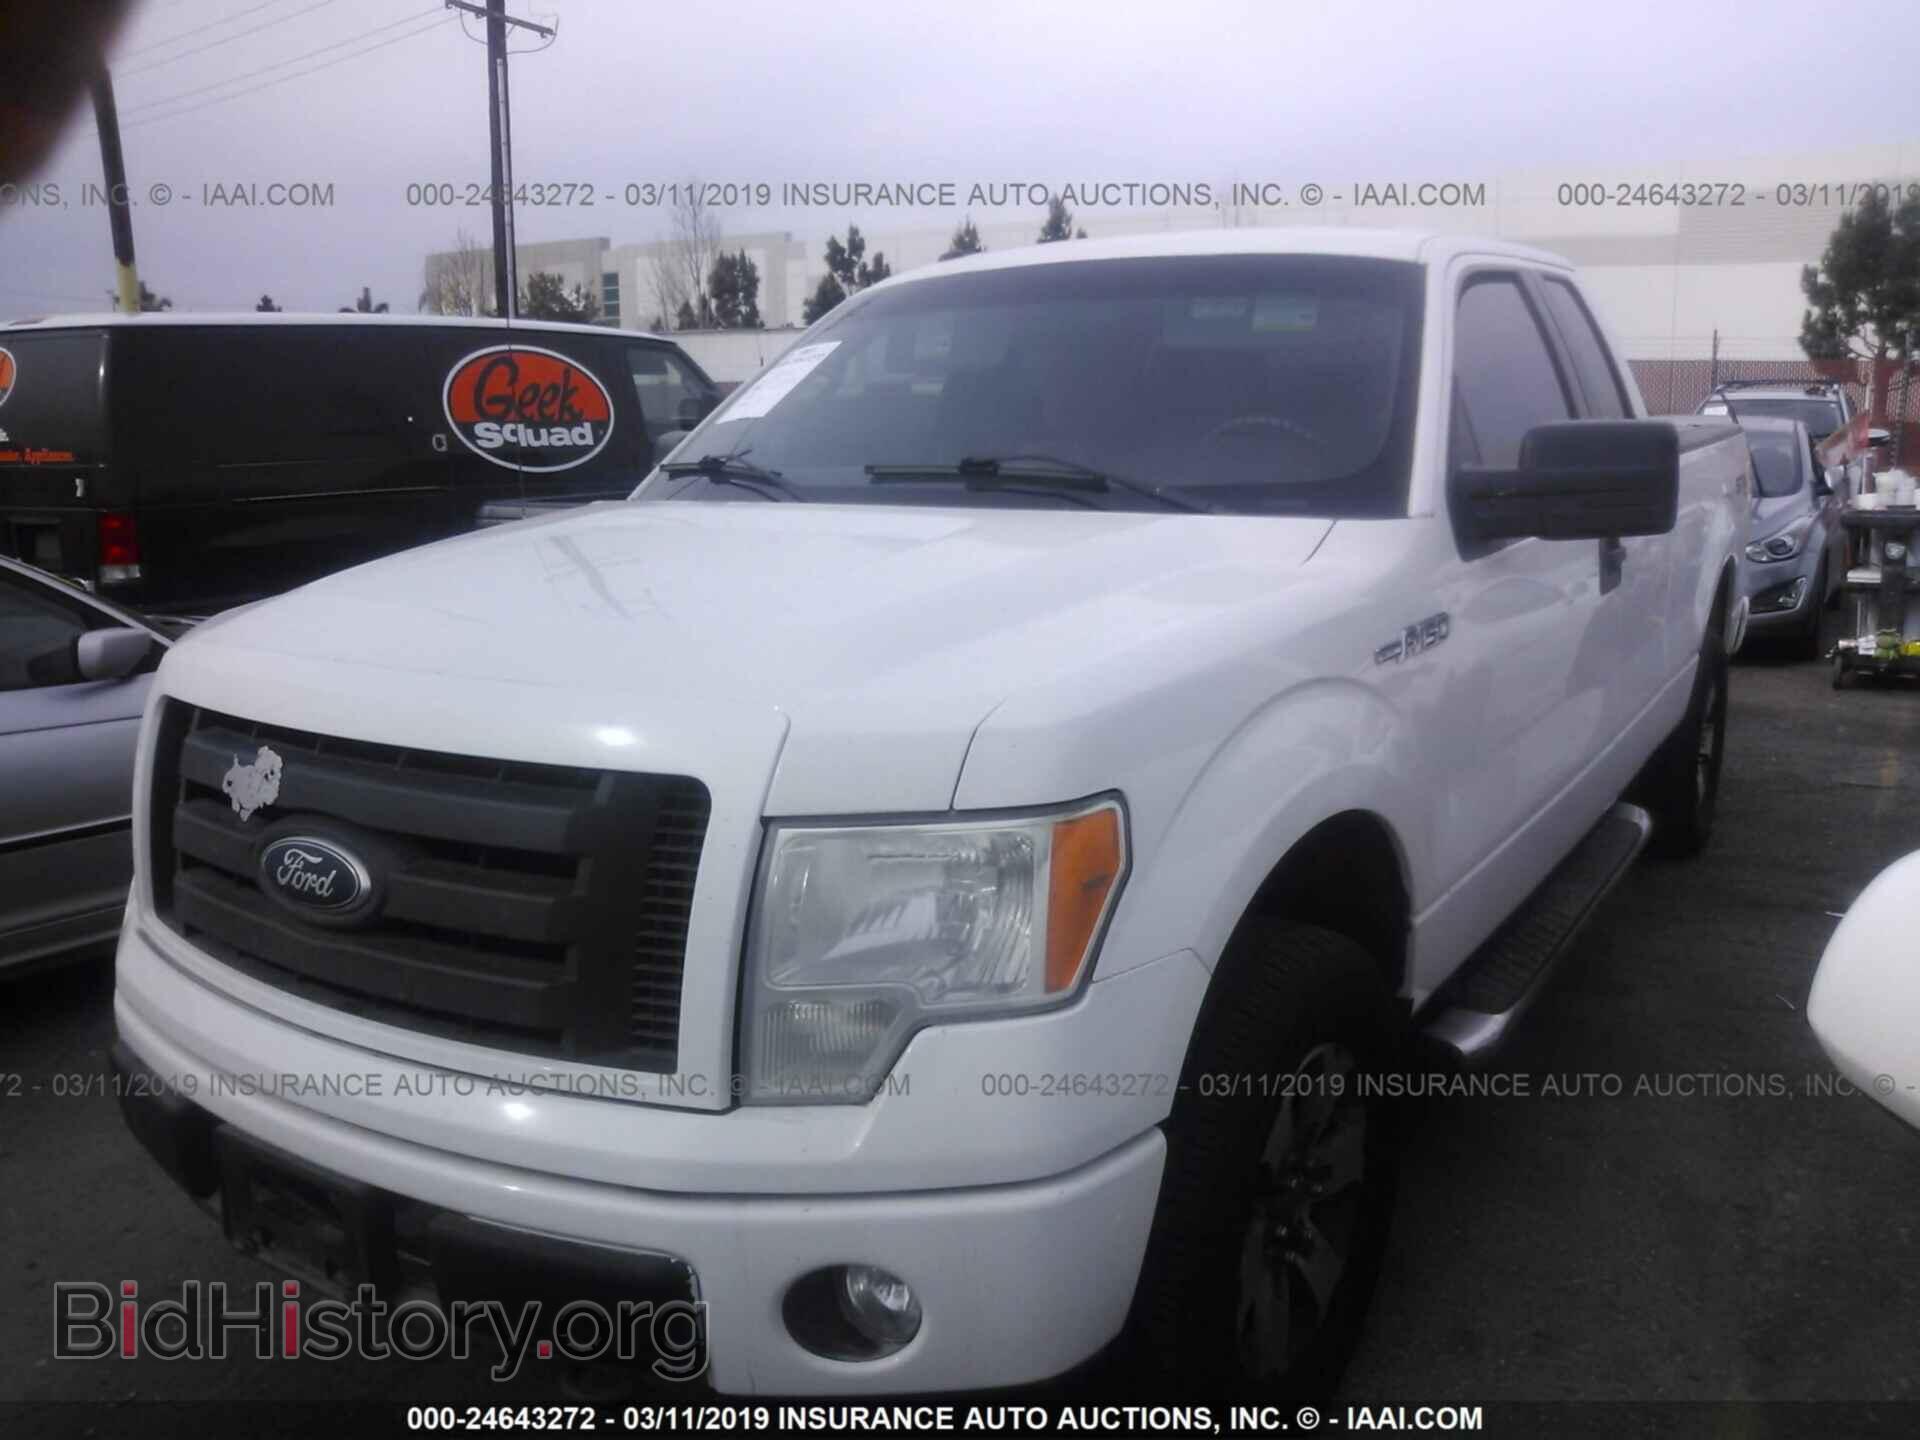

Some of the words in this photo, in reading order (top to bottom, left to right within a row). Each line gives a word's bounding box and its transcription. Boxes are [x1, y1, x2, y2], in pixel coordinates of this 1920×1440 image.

[474, 356, 584, 423] Geek
[474, 422, 594, 448] Squad
[276, 848, 337, 897] Ford
